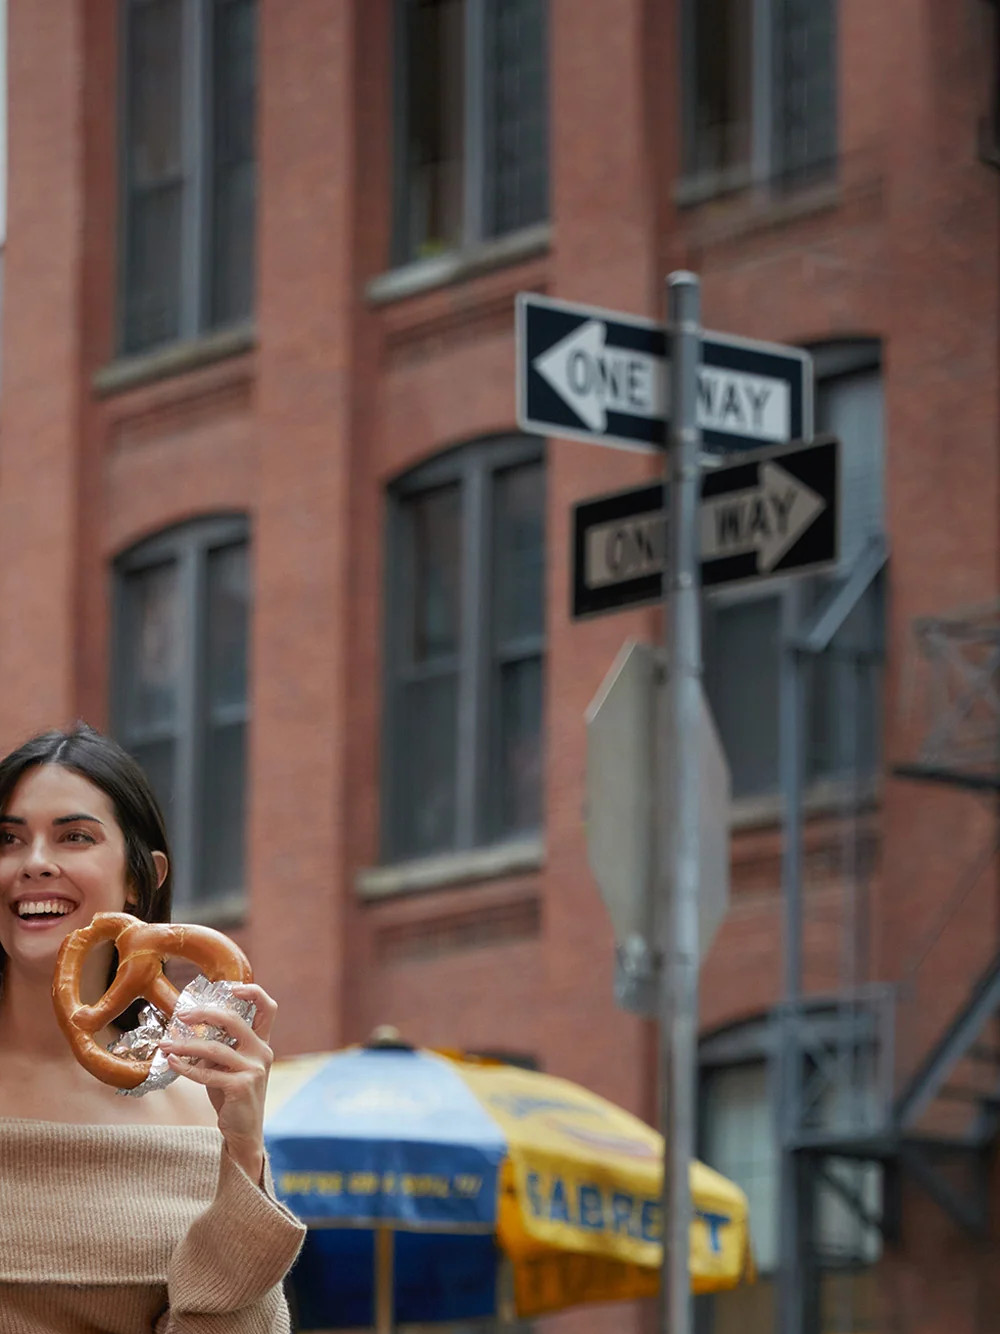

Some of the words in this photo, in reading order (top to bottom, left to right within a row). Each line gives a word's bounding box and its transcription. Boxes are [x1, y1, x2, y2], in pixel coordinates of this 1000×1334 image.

[565, 348, 647, 408] ONE
[604, 518, 660, 576] ON
[714, 486, 799, 548] WAY
[526, 1170, 732, 1255] SABRET
